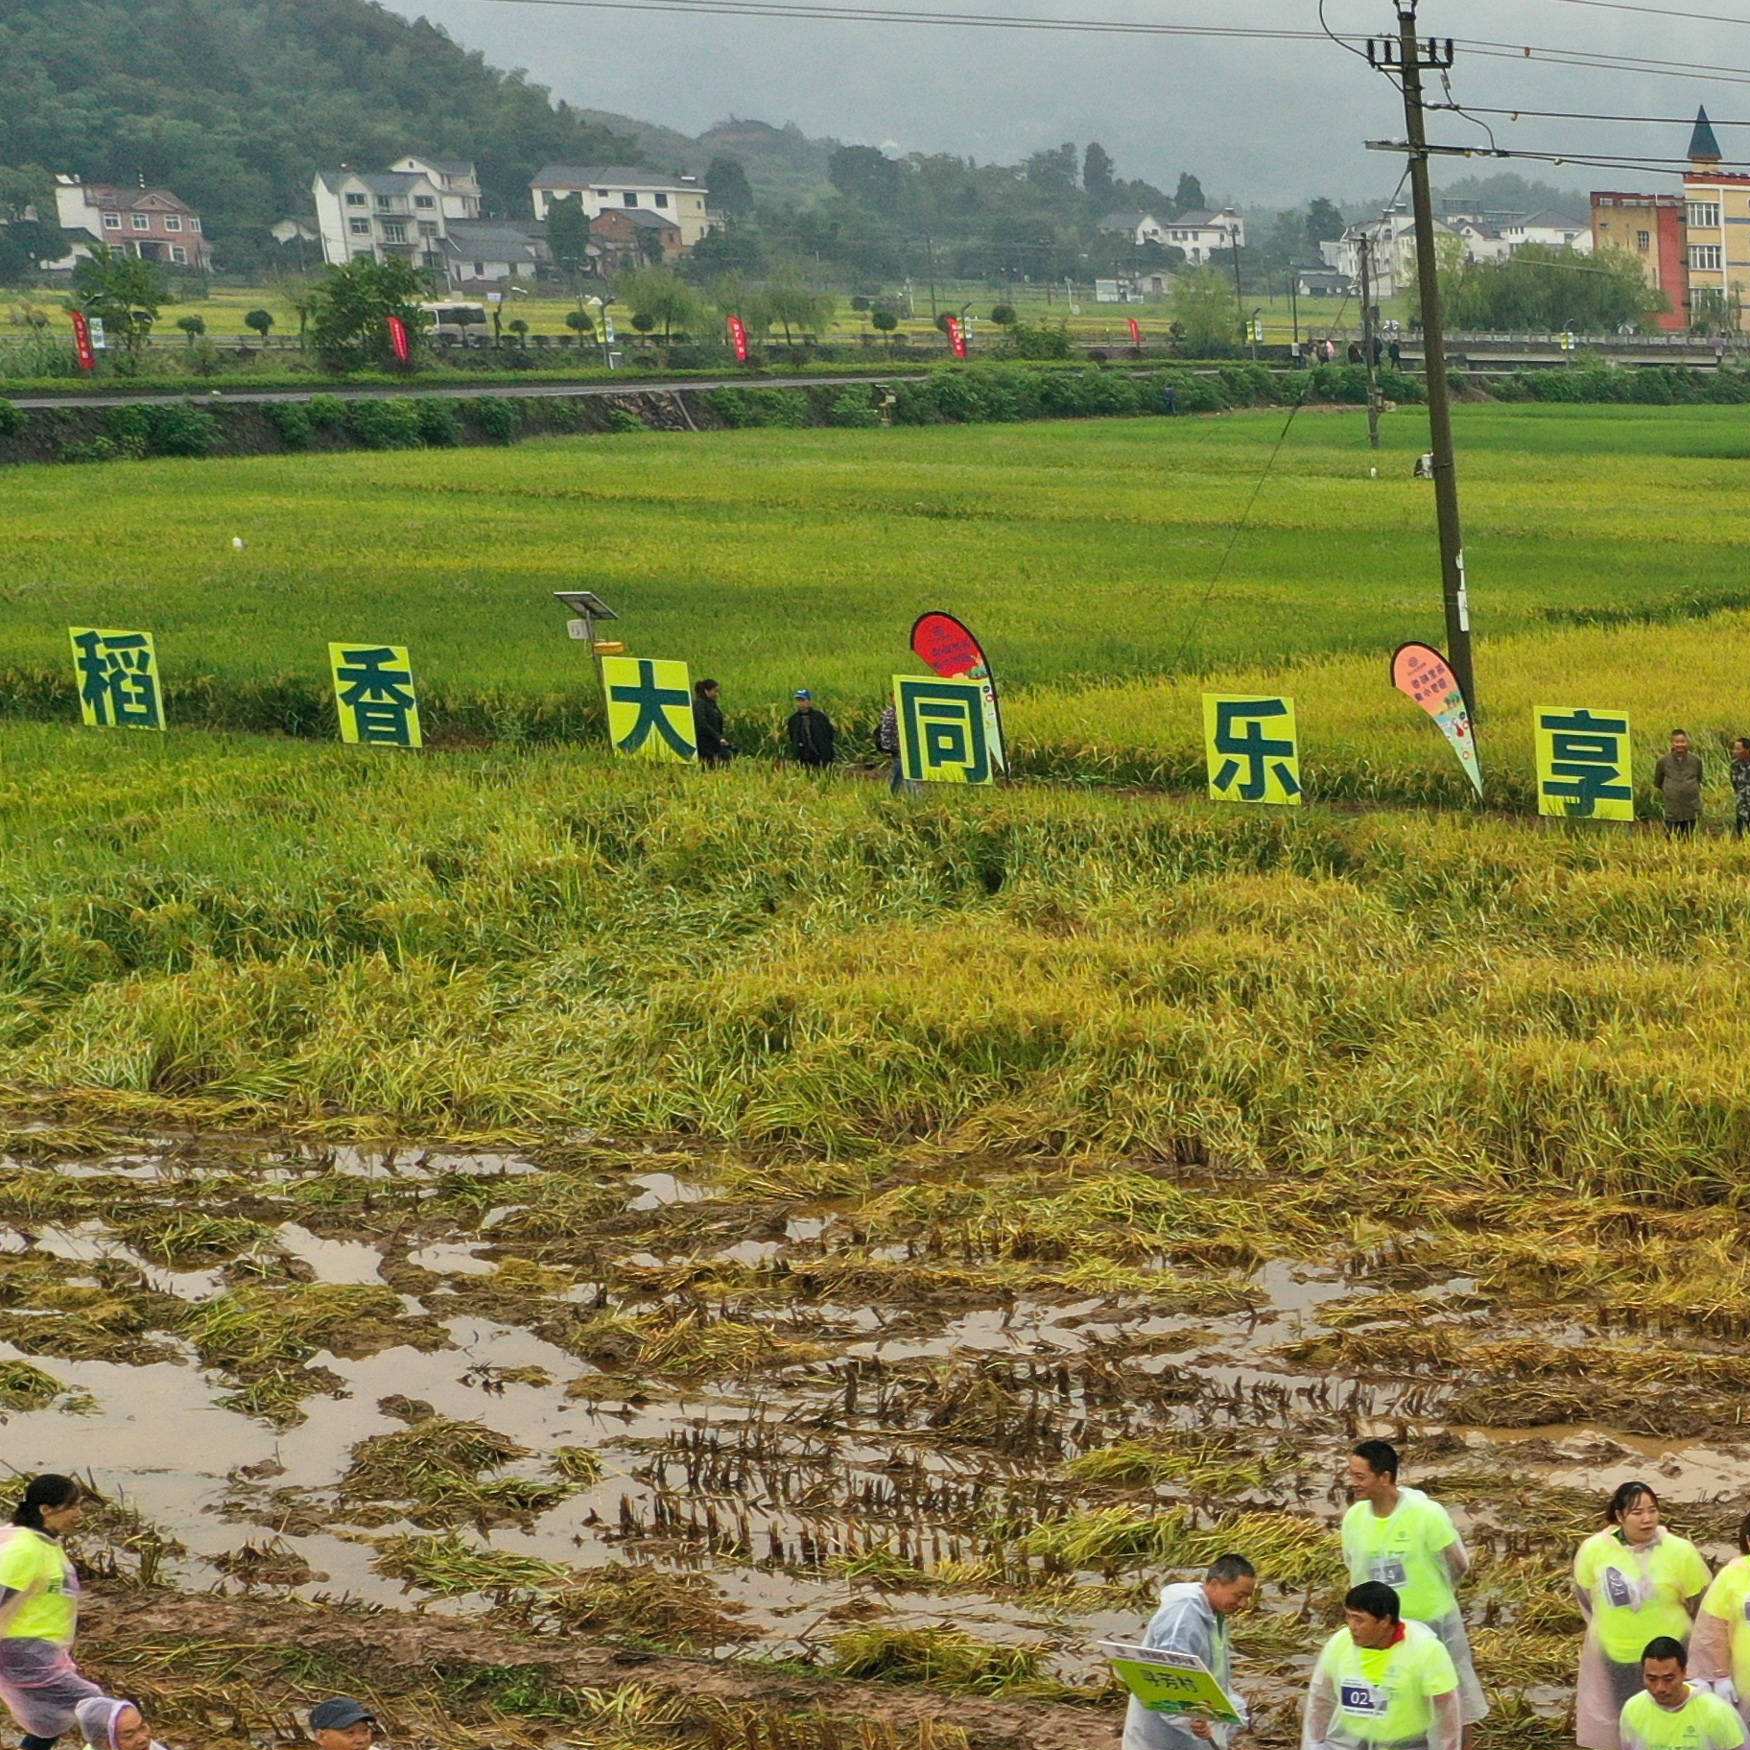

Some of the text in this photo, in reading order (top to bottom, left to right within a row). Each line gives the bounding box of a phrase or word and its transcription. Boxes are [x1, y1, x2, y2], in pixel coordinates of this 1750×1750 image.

[75, 633, 161, 725] 稻
[338, 648, 415, 746] 香
[610, 660, 696, 755] 大
[900, 681, 988, 782] 同
[1213, 699, 1300, 797] 乐
[1542, 710, 1631, 816] 享
